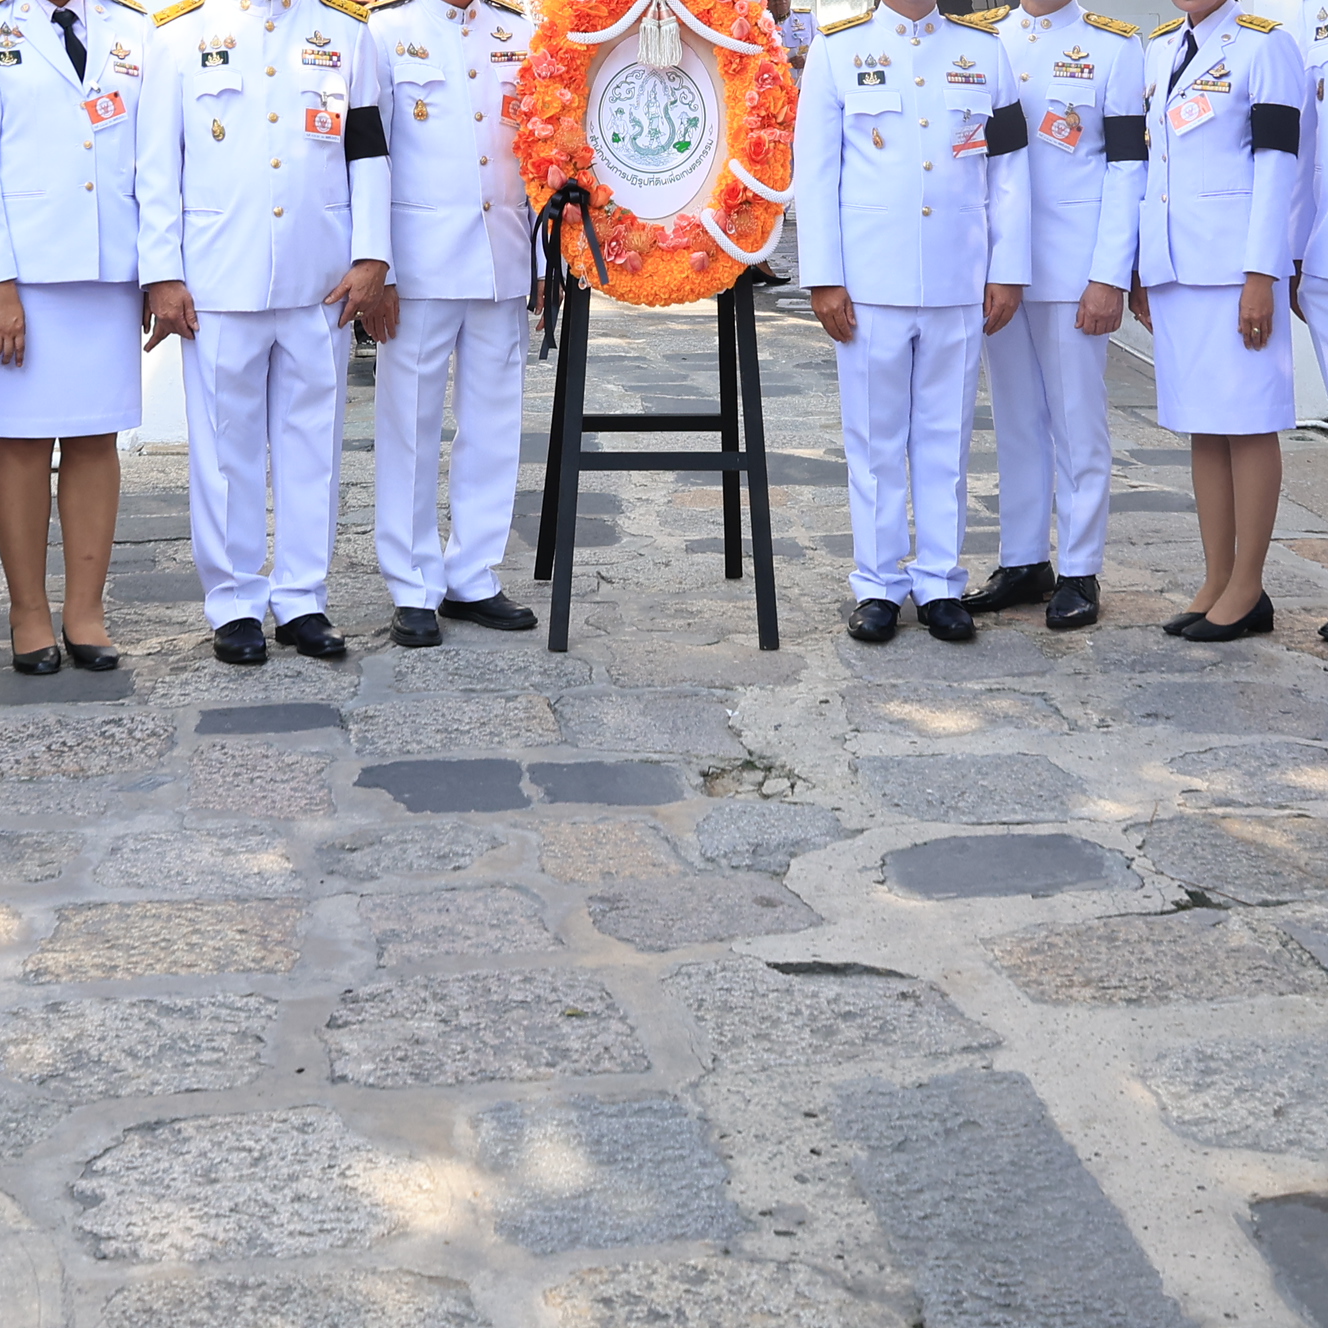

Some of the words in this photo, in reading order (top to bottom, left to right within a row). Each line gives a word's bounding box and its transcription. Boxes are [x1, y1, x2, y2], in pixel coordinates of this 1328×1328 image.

[590, 135, 714, 188] สำนักงานการปฏิรูปที่ดินเพื่อเกษตรกรรม
